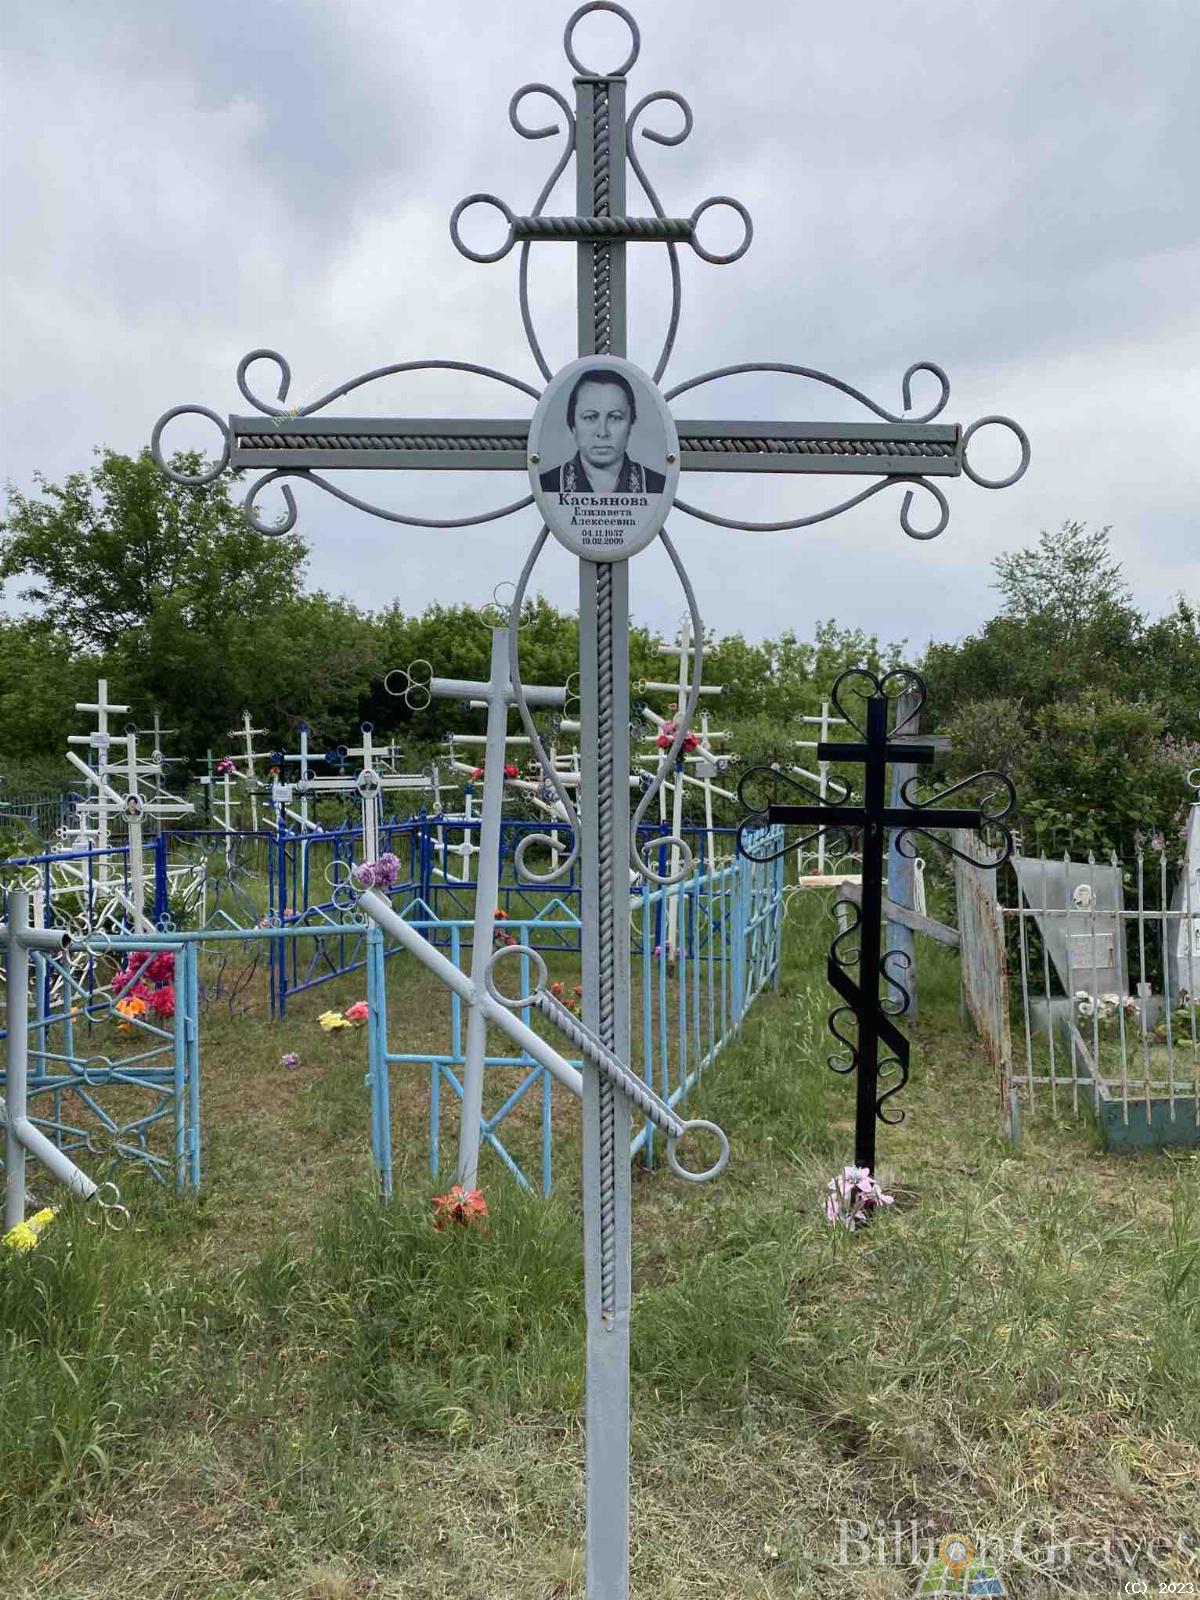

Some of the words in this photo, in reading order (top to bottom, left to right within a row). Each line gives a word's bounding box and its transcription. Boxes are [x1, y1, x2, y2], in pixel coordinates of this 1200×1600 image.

[558, 493, 648, 506] Касьянова
[574, 507, 632, 516] Елизавета
[571, 517, 636, 526] Алексеевна
